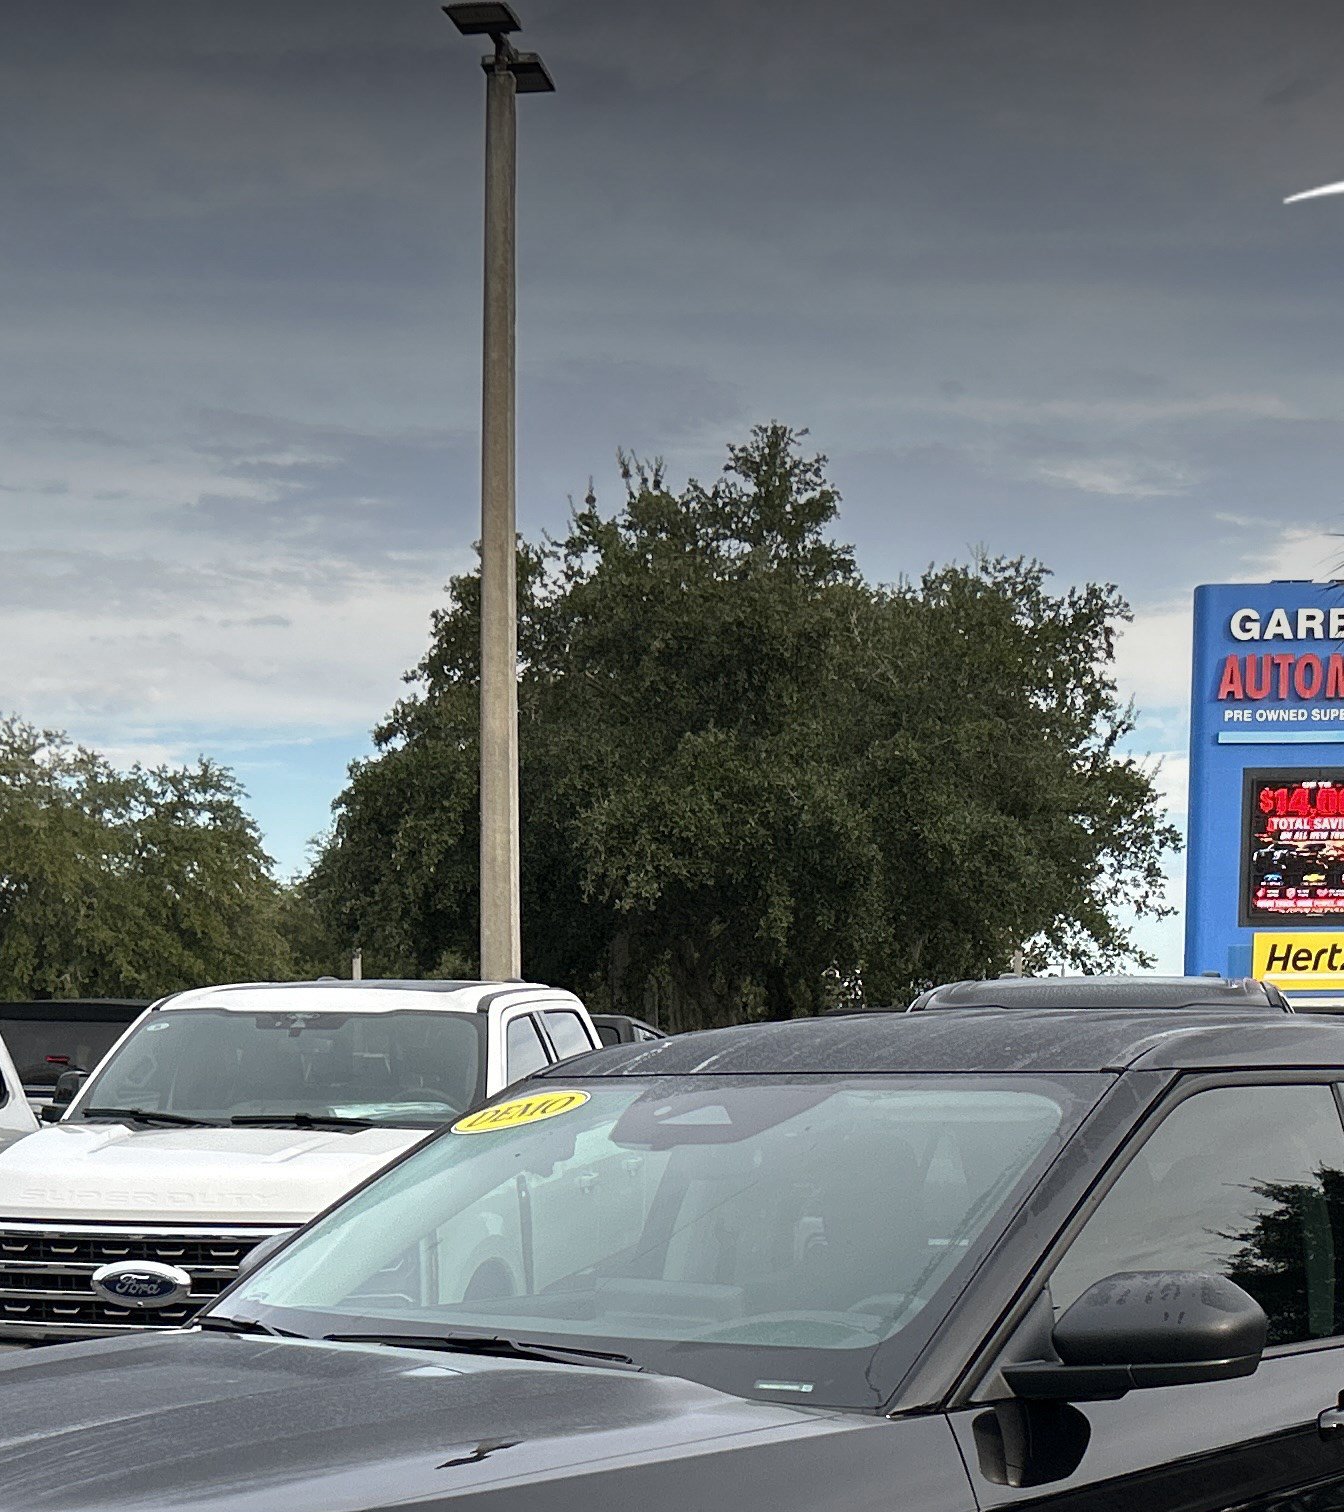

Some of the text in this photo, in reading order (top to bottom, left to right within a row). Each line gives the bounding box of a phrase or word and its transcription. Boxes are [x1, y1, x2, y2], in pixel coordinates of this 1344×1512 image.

[1223, 709, 1253, 722] PRE
[1255, 708, 1308, 722] OWNED
[1272, 817, 1310, 830] TOTAL
[466, 1096, 576, 1128] DEMO
[19, 1188, 159, 1204] SUPER
[116, 1273, 162, 1295] Ford
